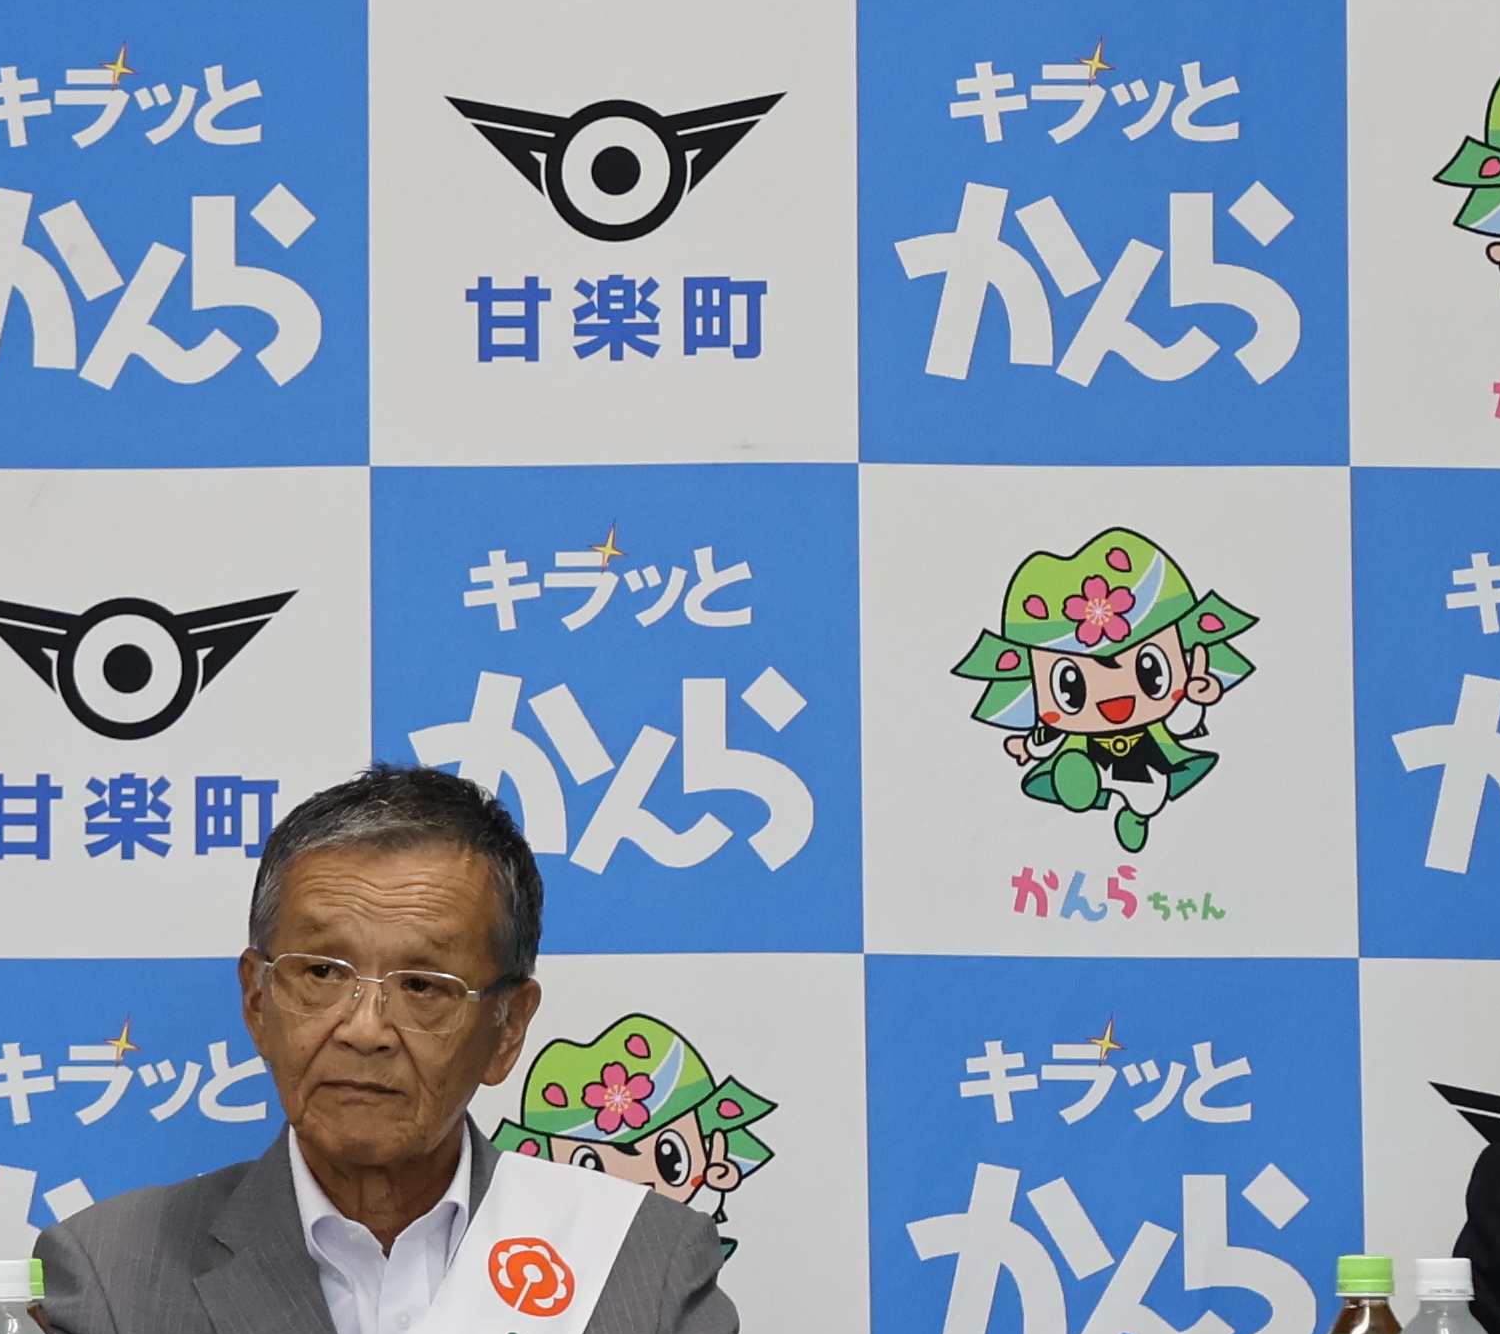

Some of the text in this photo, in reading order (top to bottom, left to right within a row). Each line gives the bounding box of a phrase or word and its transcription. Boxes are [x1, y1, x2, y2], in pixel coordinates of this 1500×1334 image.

[950, 62, 1239, 143] キラッと
[467, 275, 766, 362] 甘楽町
[895, 182, 1301, 386] かんら
[464, 545, 752, 630] キラッと
[409, 667, 814, 873] かんら
[1012, 866, 1223, 921] かんらちゃん
[960, 1039, 1251, 1123] キラッと
